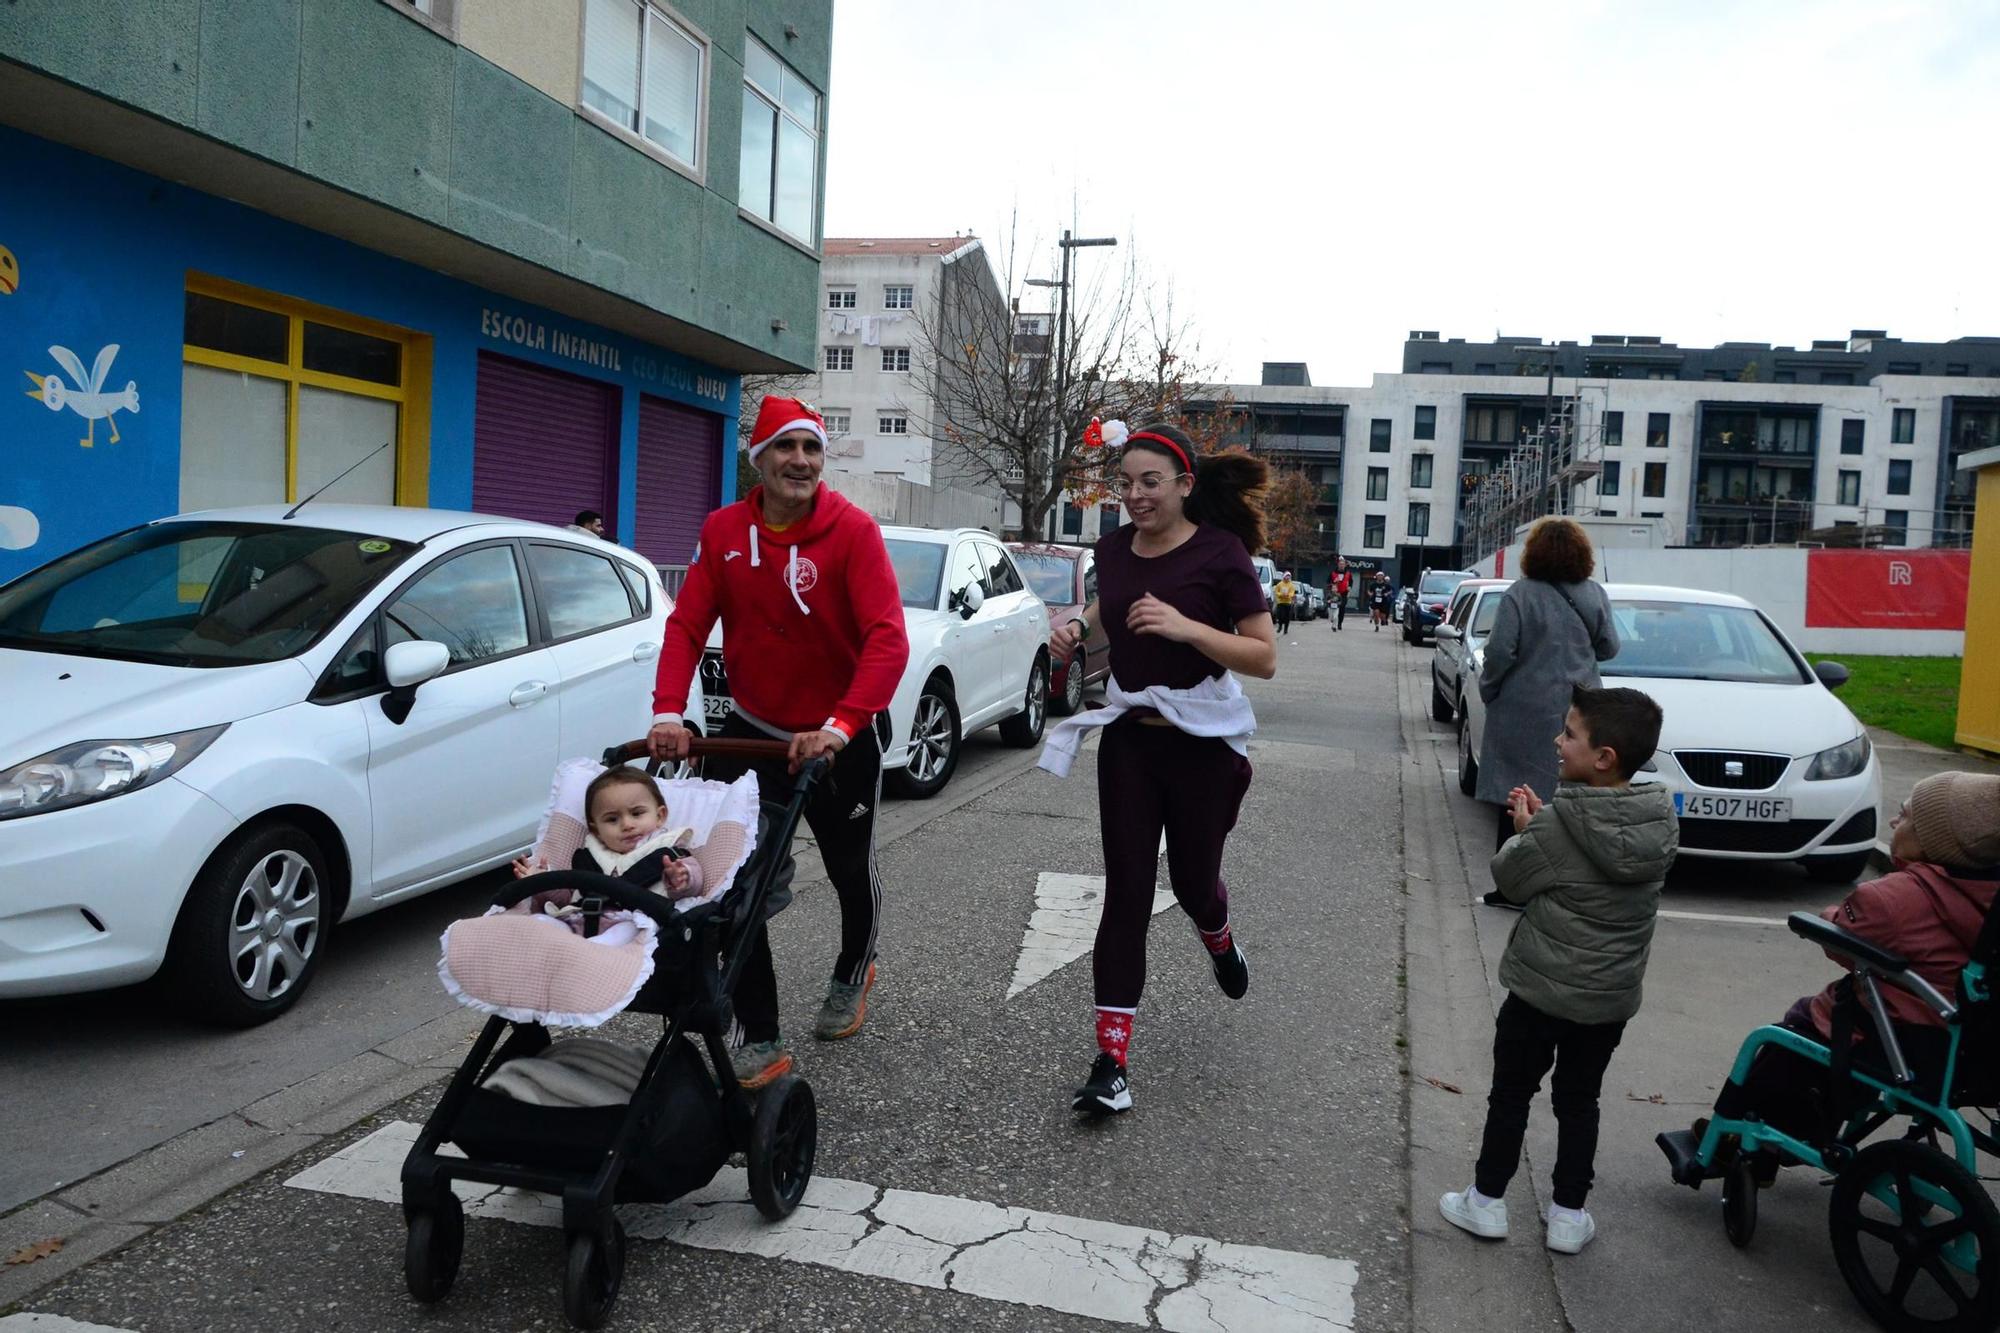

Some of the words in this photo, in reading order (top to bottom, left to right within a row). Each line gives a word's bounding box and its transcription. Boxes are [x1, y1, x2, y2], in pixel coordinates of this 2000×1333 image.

[481, 308, 545, 349] ESCOLA
[552, 329, 621, 371] INFANTIL
[662, 364, 693, 392] AZUL
[697, 376, 727, 402] BUEU
[1688, 796, 1741, 817] 4507
[1745, 800, 1784, 819] HGF
